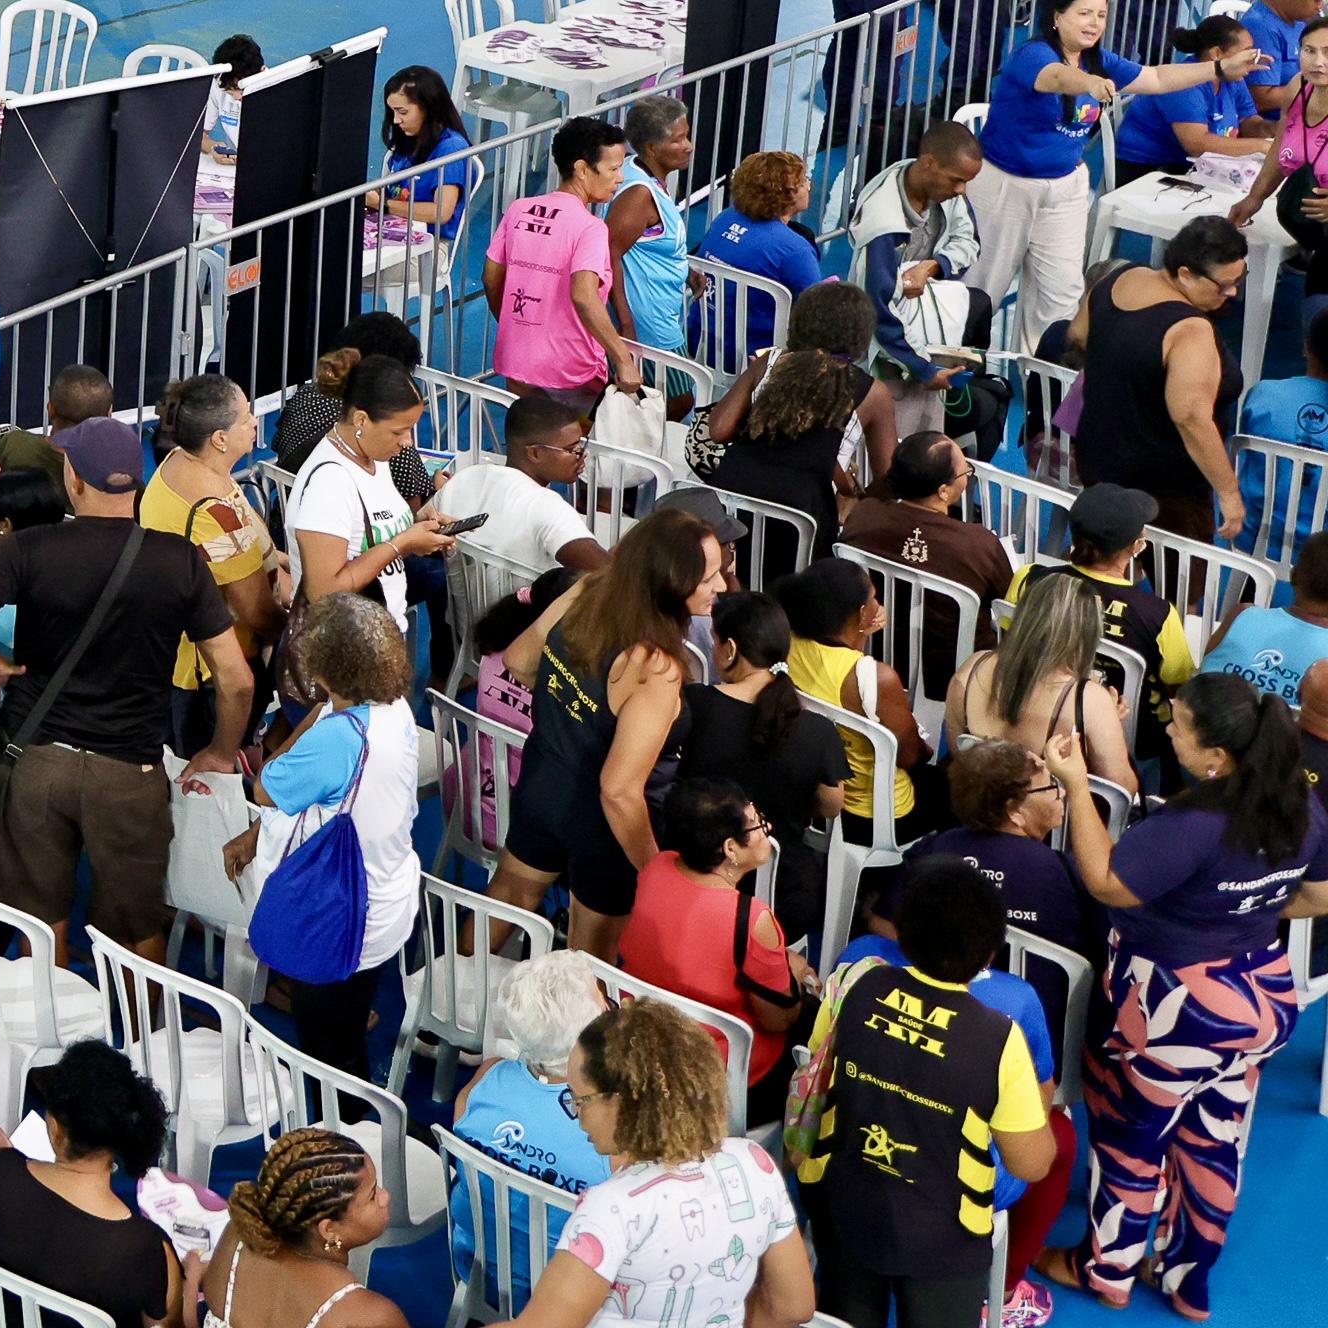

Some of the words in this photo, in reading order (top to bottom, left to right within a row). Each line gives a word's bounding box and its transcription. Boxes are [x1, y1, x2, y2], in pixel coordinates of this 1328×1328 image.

[228, 263, 258, 289] ELO
[898, 1015, 923, 1031] SAÚDE
[858, 1071, 954, 1116] @SANDROCROSSBOXE
[503, 1135, 557, 1165] SANDRO
